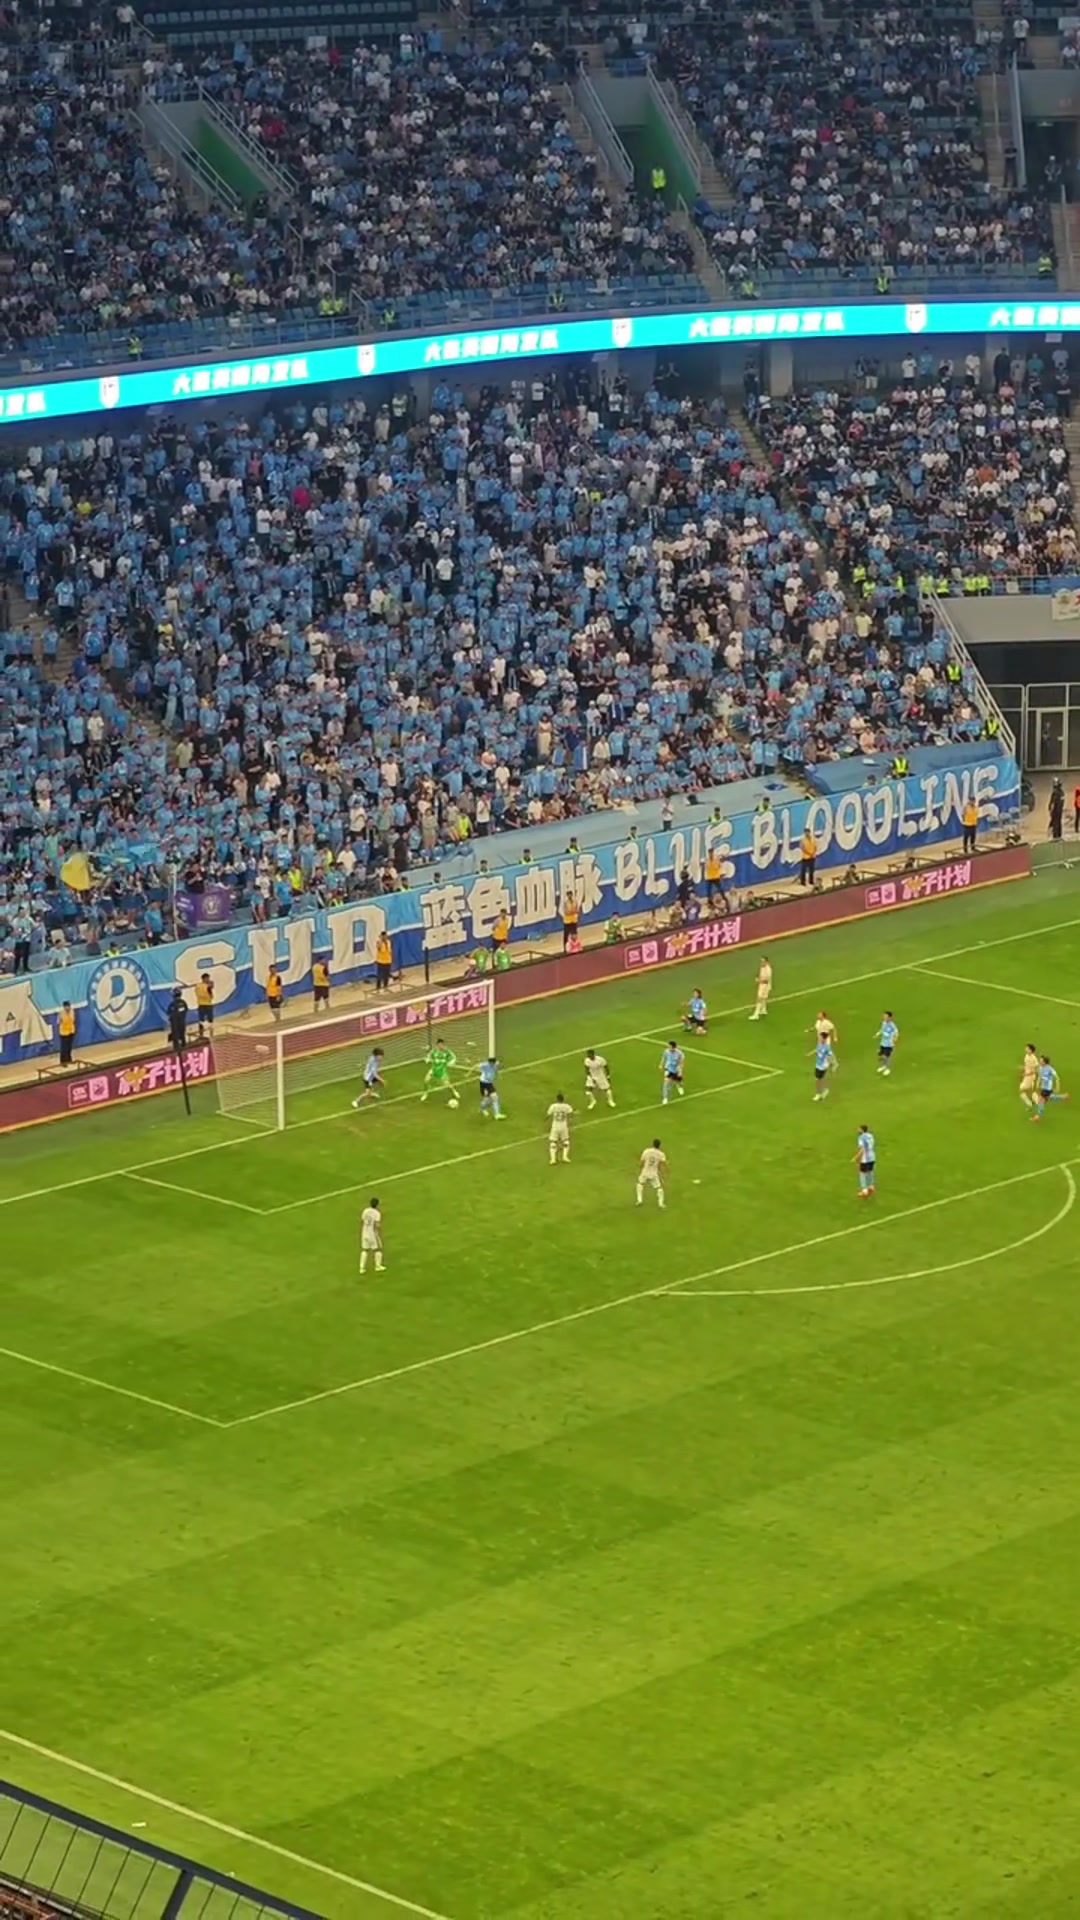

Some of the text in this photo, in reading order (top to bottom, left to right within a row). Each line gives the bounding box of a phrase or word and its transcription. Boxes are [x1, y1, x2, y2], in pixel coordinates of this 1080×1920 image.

[614, 764, 1000, 902] BLUE BLOODLINE
[420, 853, 603, 950] 蓝色血脉
[174, 904, 387, 1010] SUD
